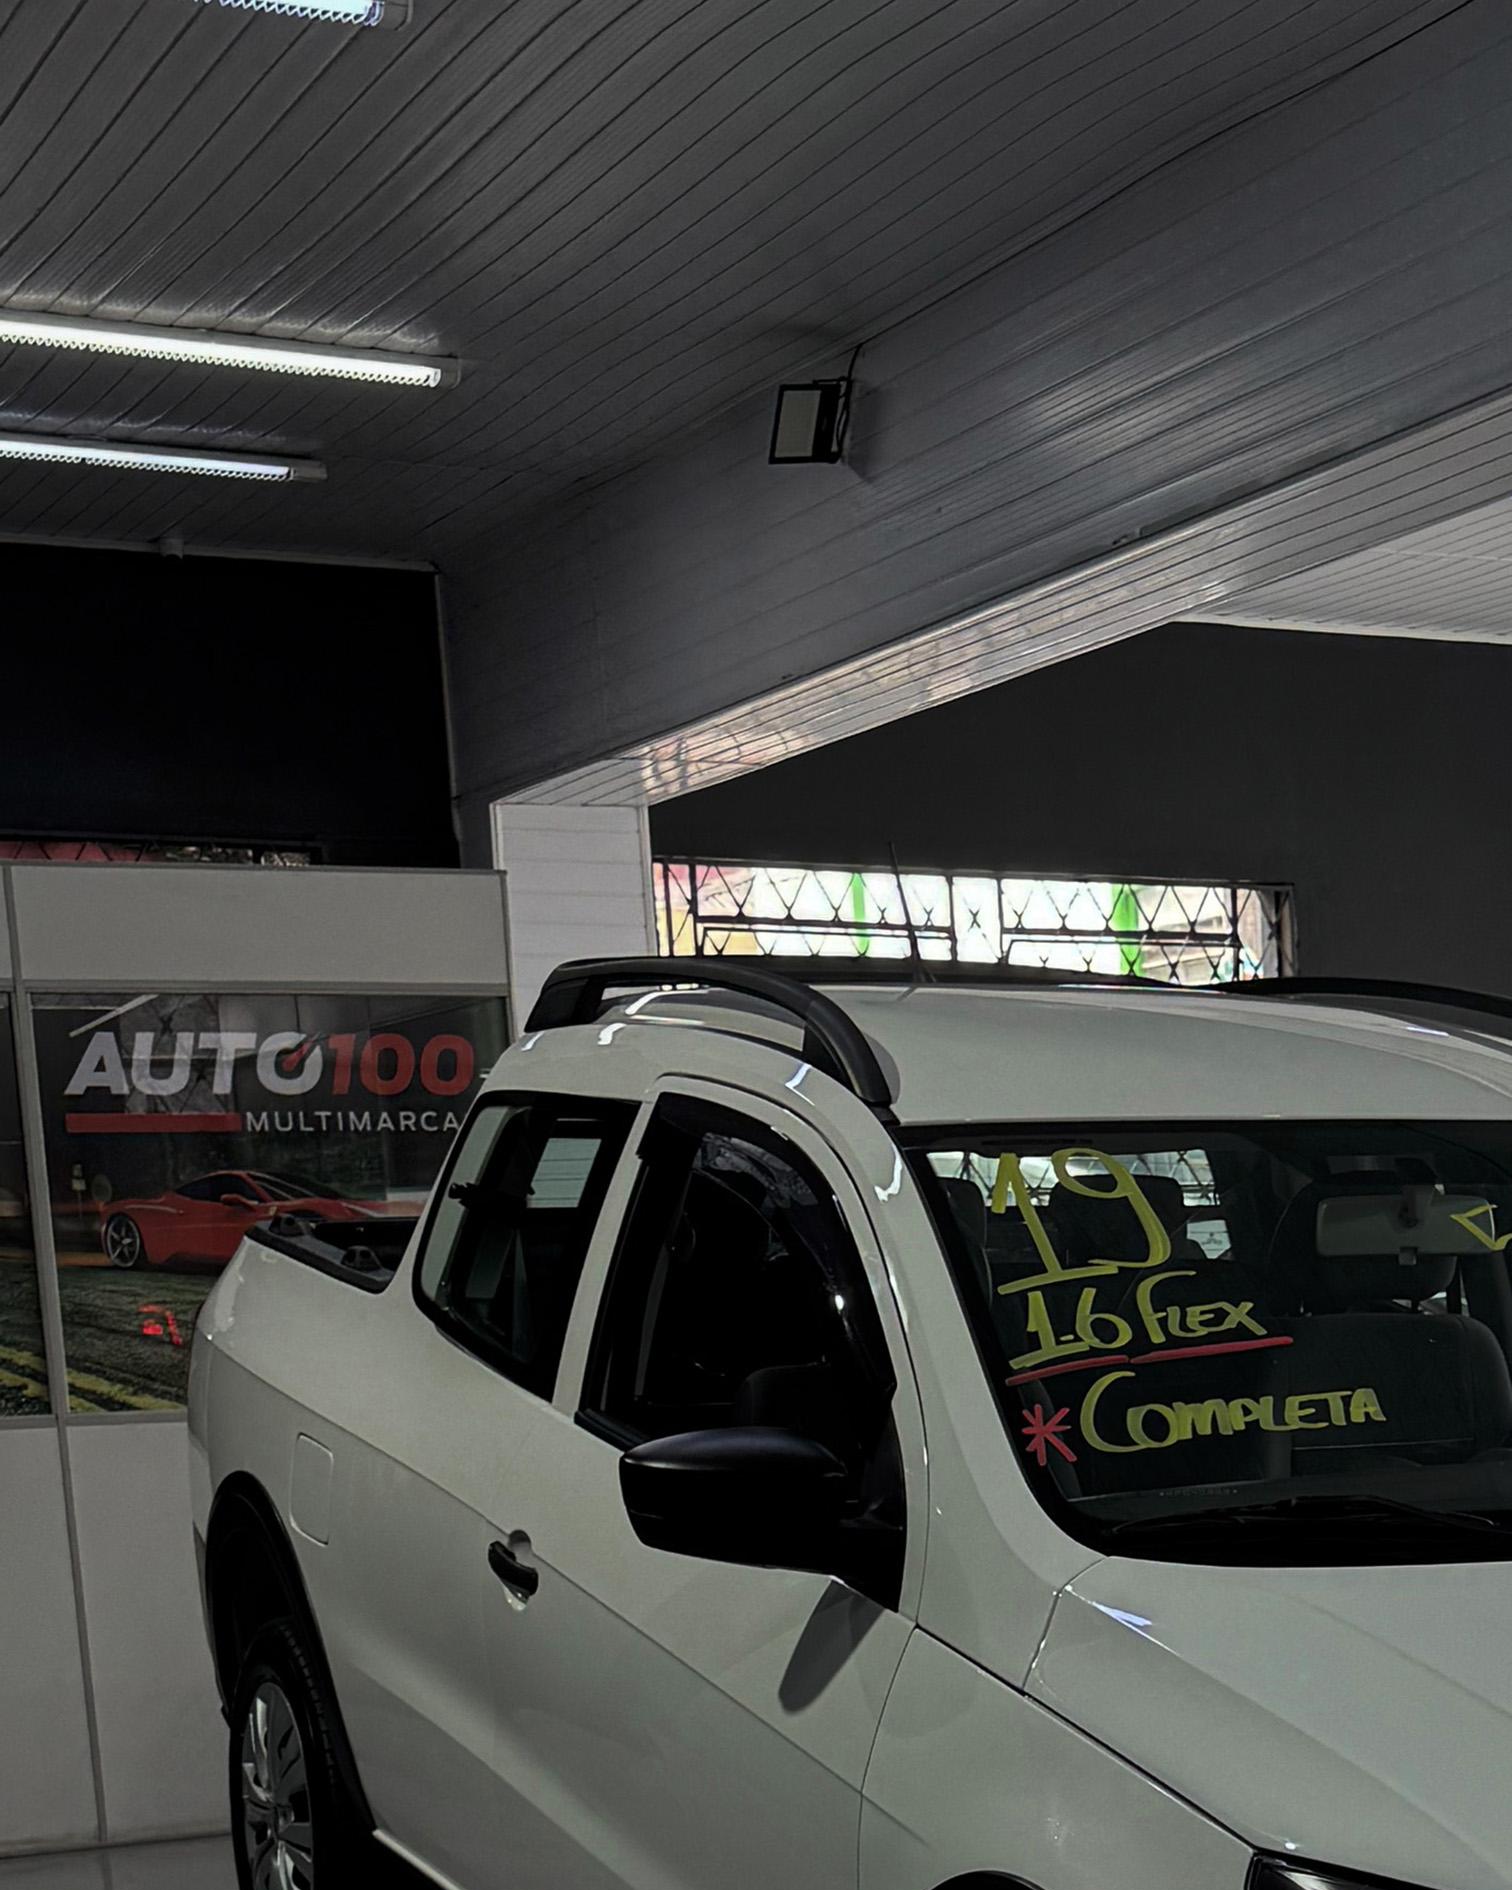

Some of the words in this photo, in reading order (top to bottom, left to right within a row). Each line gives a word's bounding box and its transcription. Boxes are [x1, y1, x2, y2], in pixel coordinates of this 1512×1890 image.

[64, 1029, 474, 1097] AUTO100
[246, 1110, 460, 1133] MULTIMARCA
[991, 1148, 1172, 1296] 19
